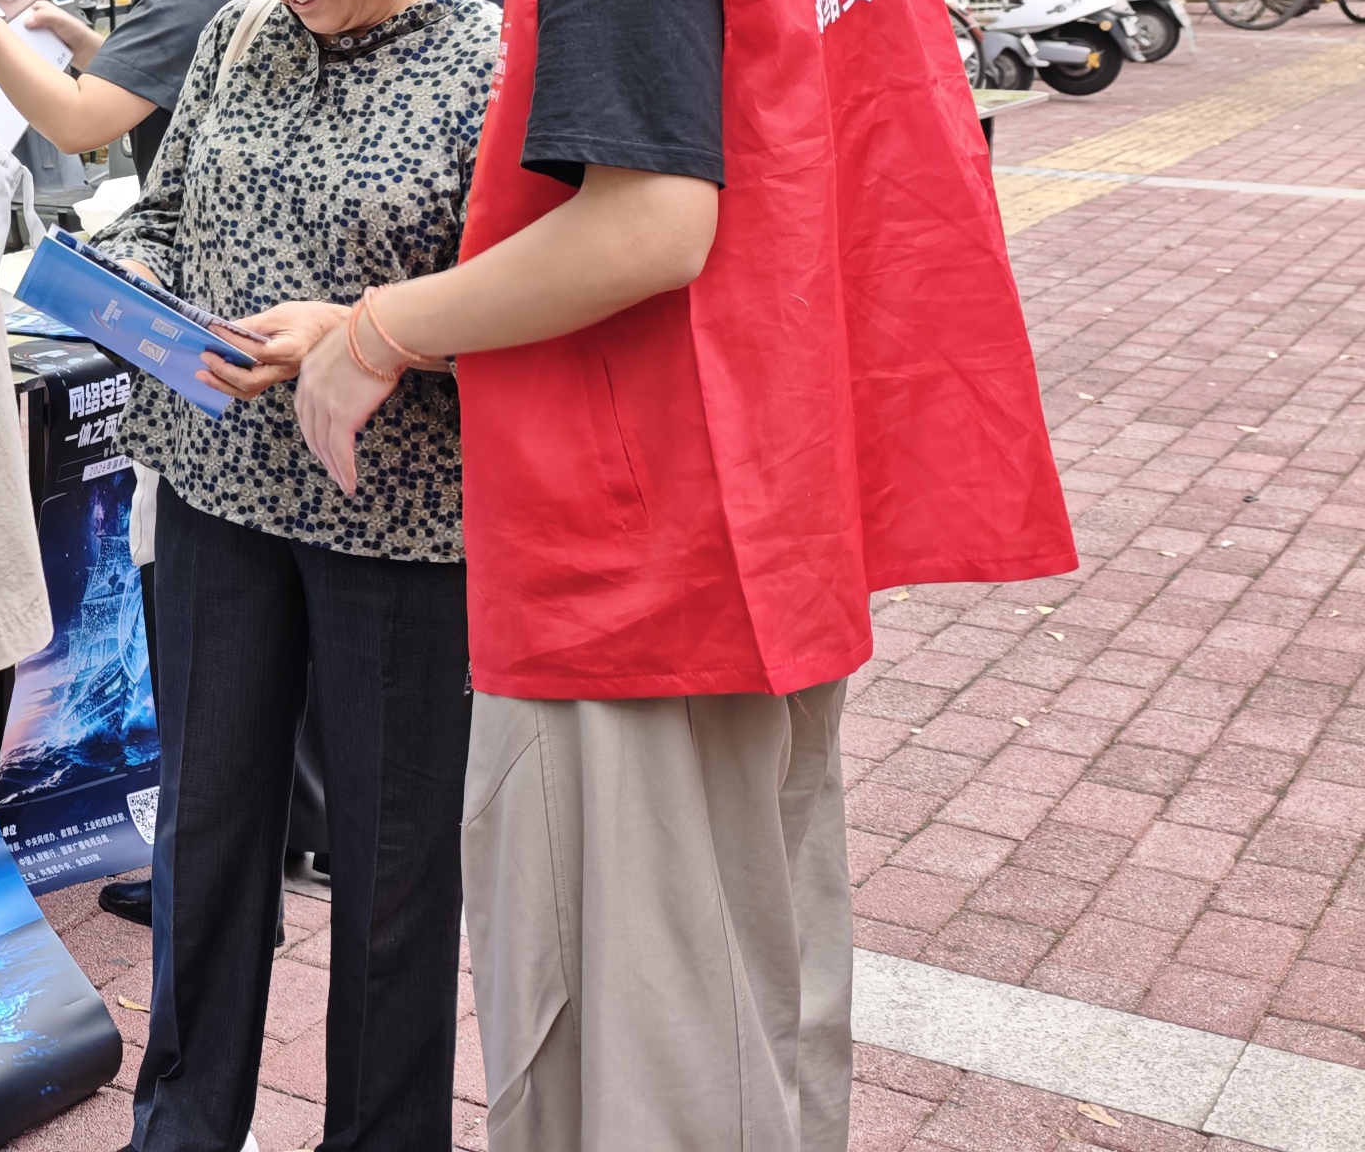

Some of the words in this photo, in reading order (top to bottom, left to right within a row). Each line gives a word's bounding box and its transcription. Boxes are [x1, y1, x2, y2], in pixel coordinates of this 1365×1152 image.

[65, 413, 121, 448] 一体之两
[88, 456, 133, 477] 2026年国家网
